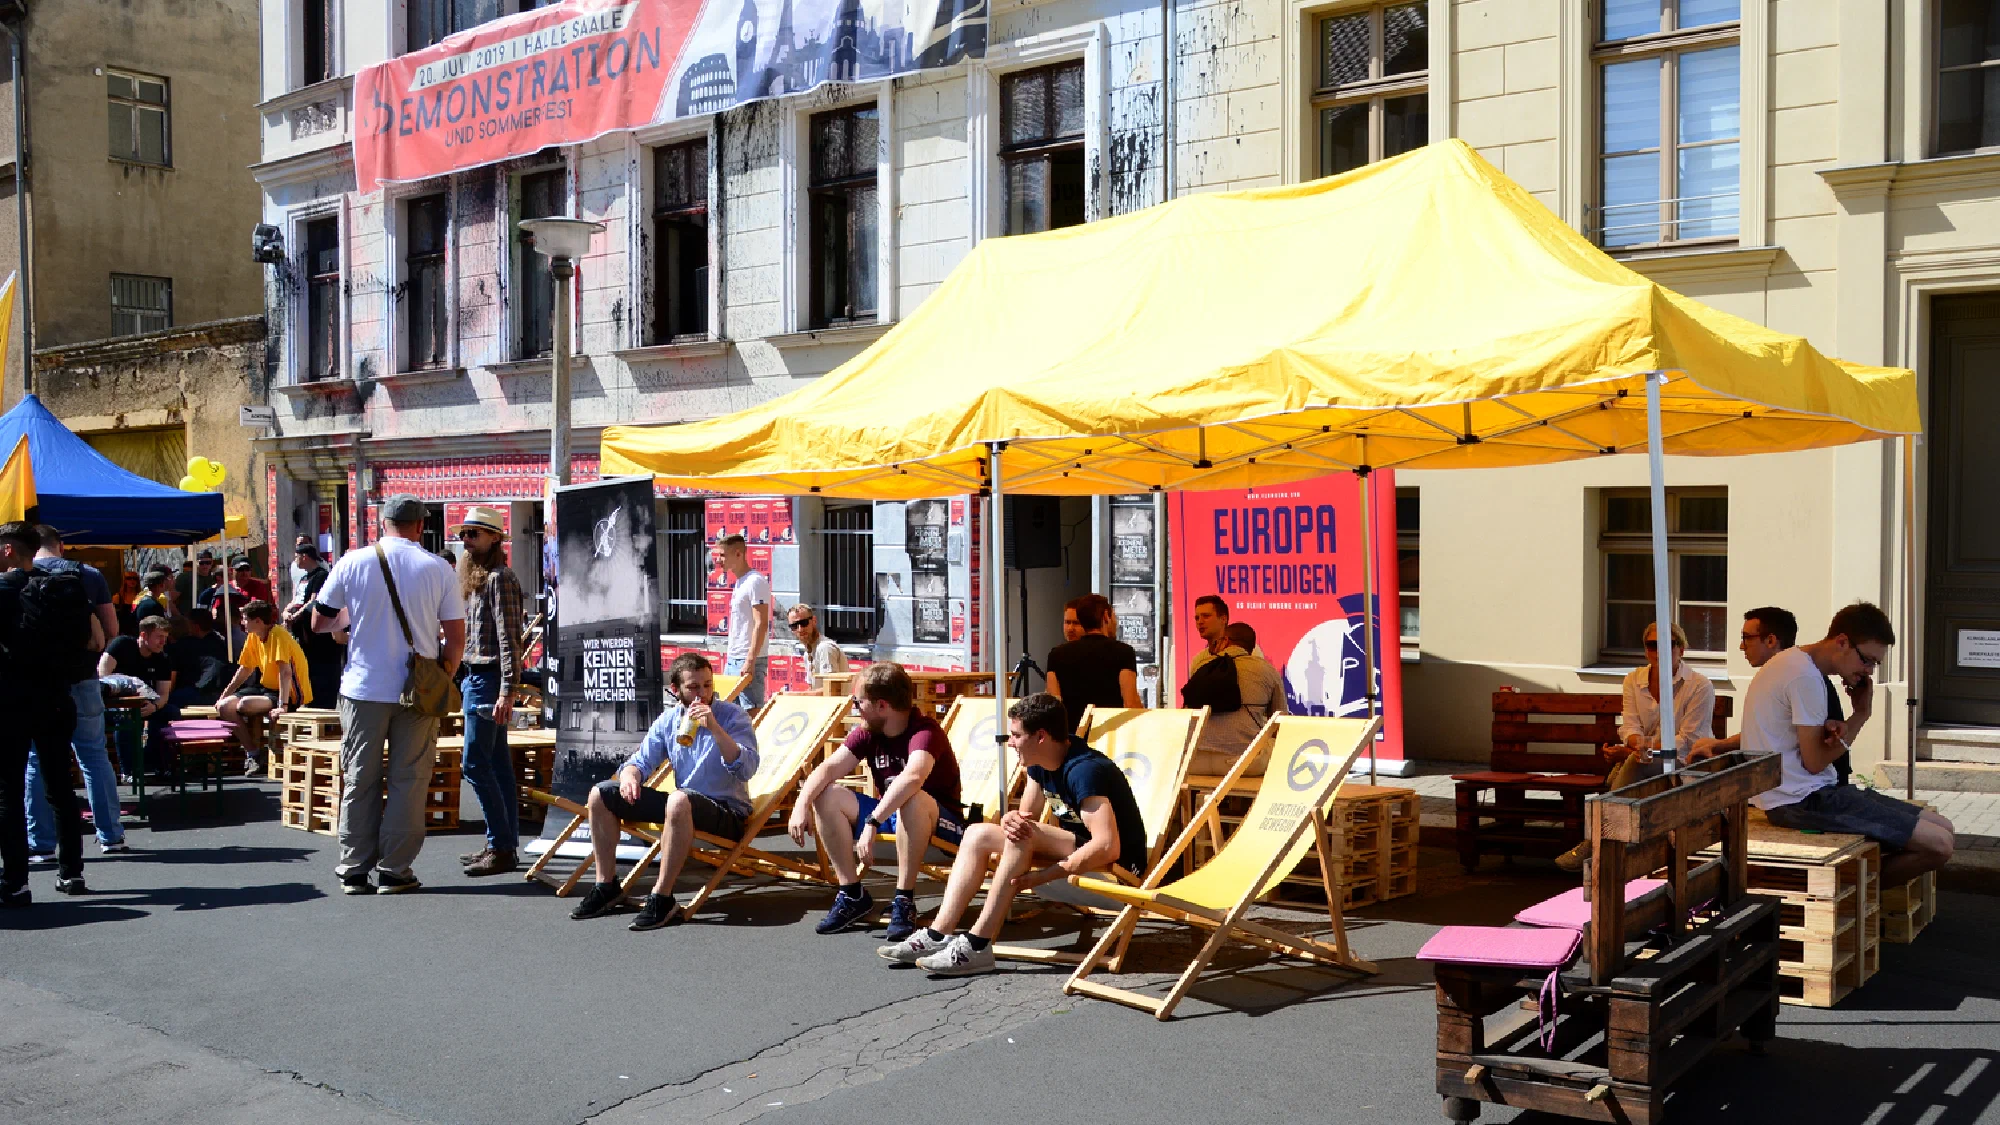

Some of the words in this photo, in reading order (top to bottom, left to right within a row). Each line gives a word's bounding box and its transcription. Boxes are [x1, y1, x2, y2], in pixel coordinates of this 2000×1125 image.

[419, 67, 437, 87] 20.
[443, 54, 471, 81] JULI
[476, 44, 506, 68] 2019
[524, 26, 568, 53] HALLE
[572, 8, 623, 38] SAALE
[445, 125, 474, 148] UND
[1213, 504, 1337, 555] EUROPA
[1215, 563, 1337, 595] VERTEIDIGEN
[583, 639, 600, 649] WIR
[600, 637, 634, 648] WERDEN
[583, 649, 634, 668] KEINEN
[583, 667, 635, 688] METER
[584, 688, 636, 701] WEICHEN!
